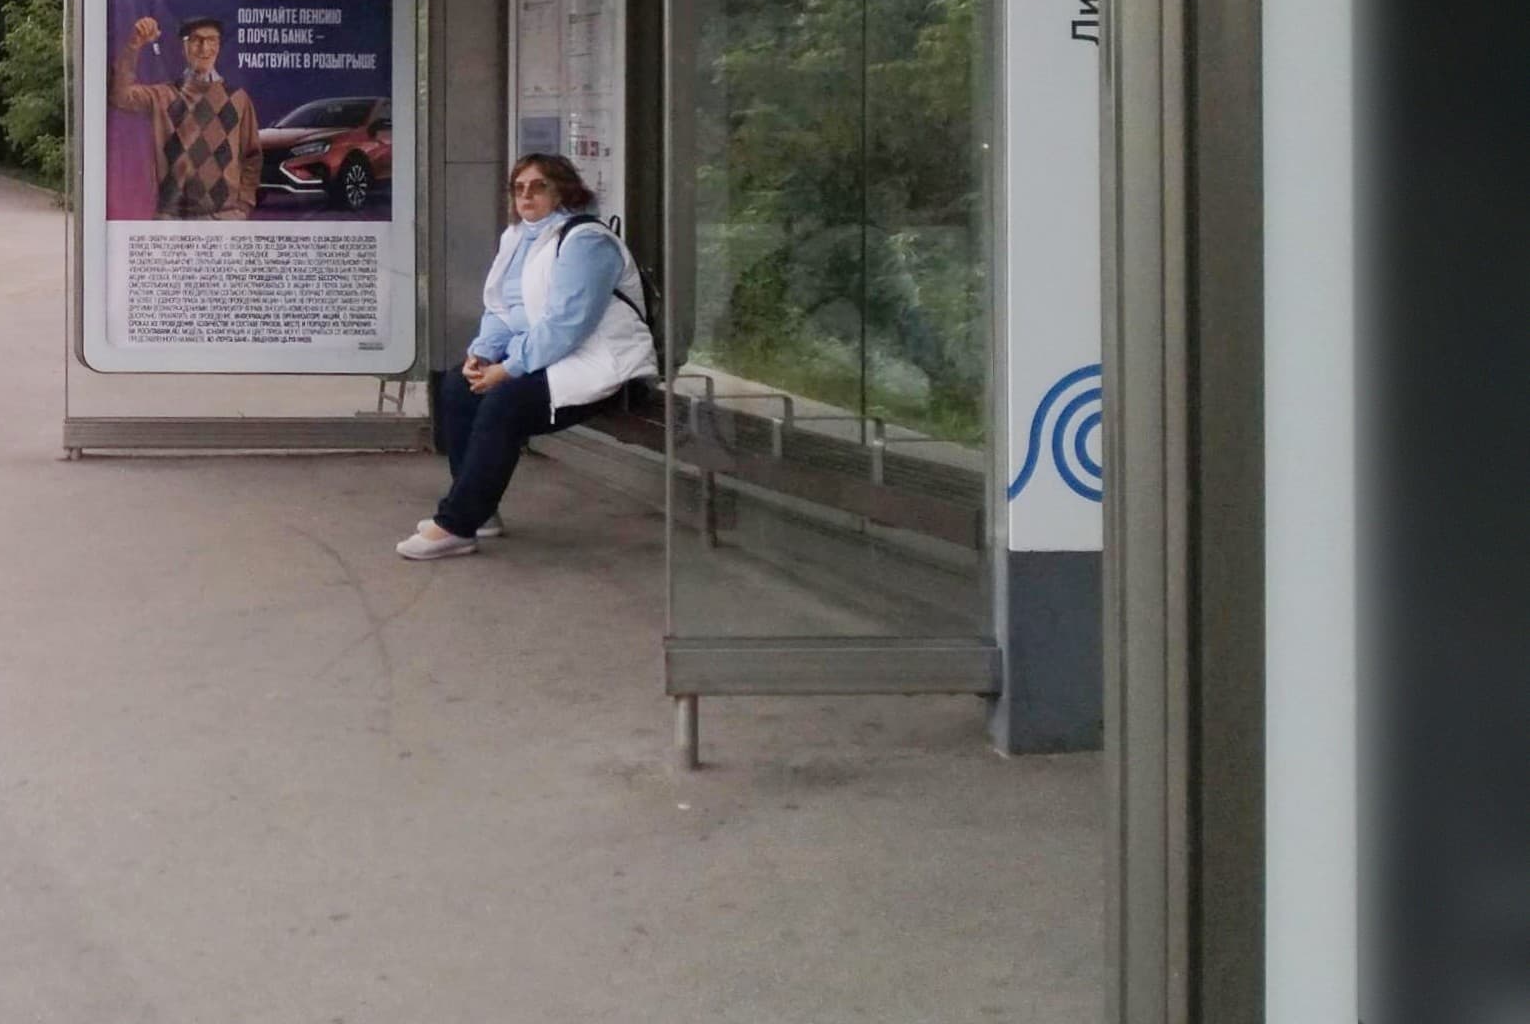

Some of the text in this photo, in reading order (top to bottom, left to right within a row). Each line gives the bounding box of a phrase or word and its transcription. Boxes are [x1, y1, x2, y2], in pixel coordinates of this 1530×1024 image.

[237, 6, 342, 25] ПОЛУЧАЙТЕ ПЕНСИЮ
[238, 28, 246, 44] В
[247, 28, 280, 44] ПОЧТА
[281, 28, 314, 45] БАНКЕ
[238, 50, 377, 69] УЧАСТВУЙТЕ В РОЗЫГРЫШЕ
